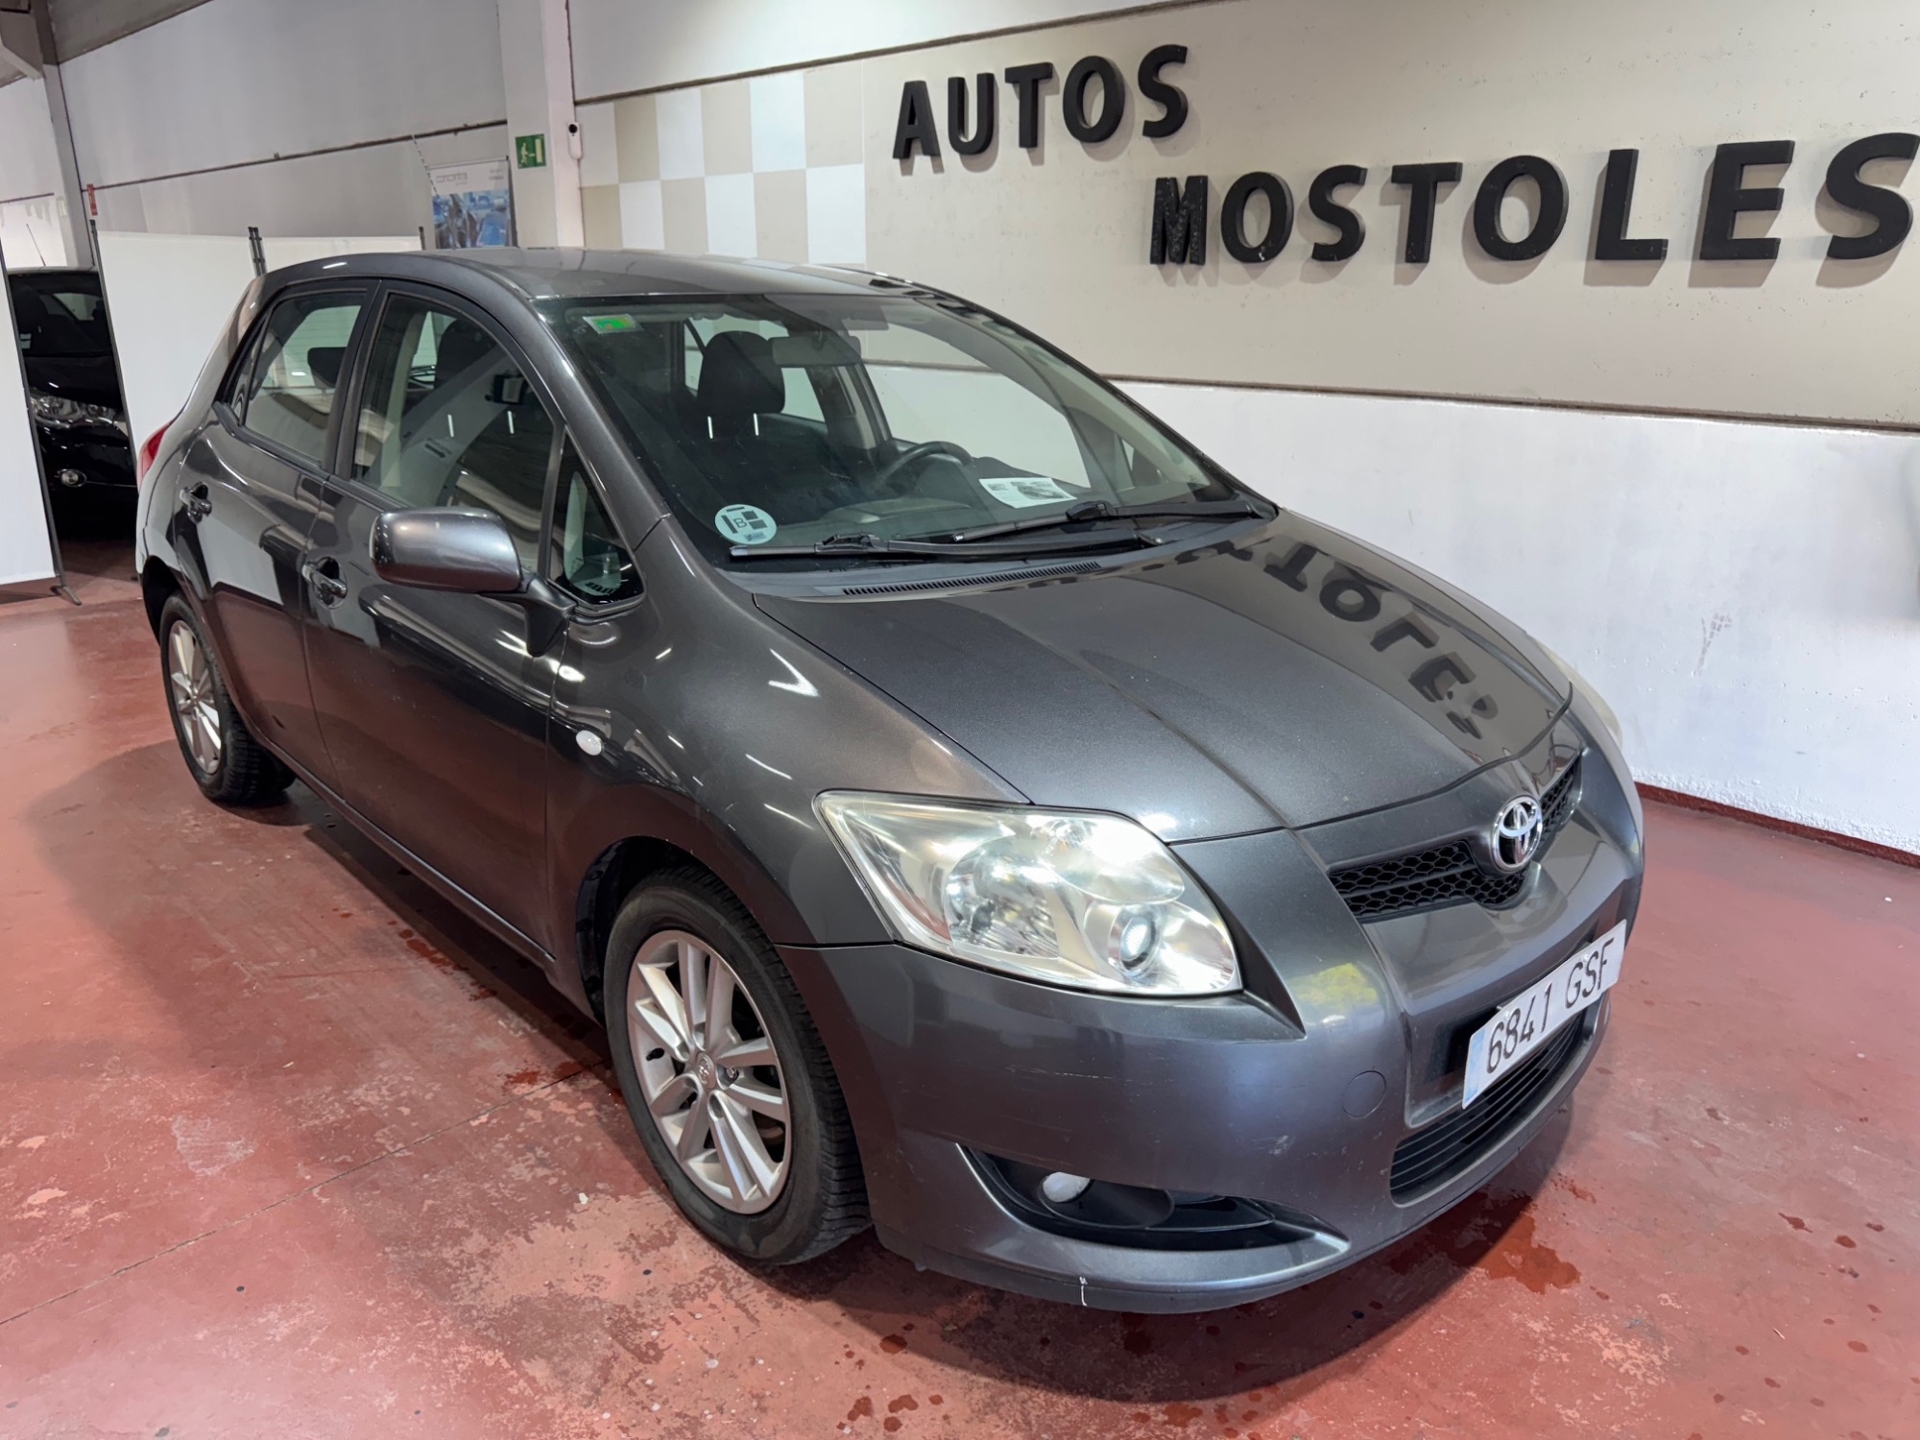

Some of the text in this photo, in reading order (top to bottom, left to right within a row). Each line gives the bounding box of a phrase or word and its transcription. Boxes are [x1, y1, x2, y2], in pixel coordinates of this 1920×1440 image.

[893, 44, 1189, 160] AUTOS
[1150, 132, 1920, 265] MOSTOLES
[733, 517, 748, 528] B
[1486, 937, 1615, 1075] 6841 GSF
